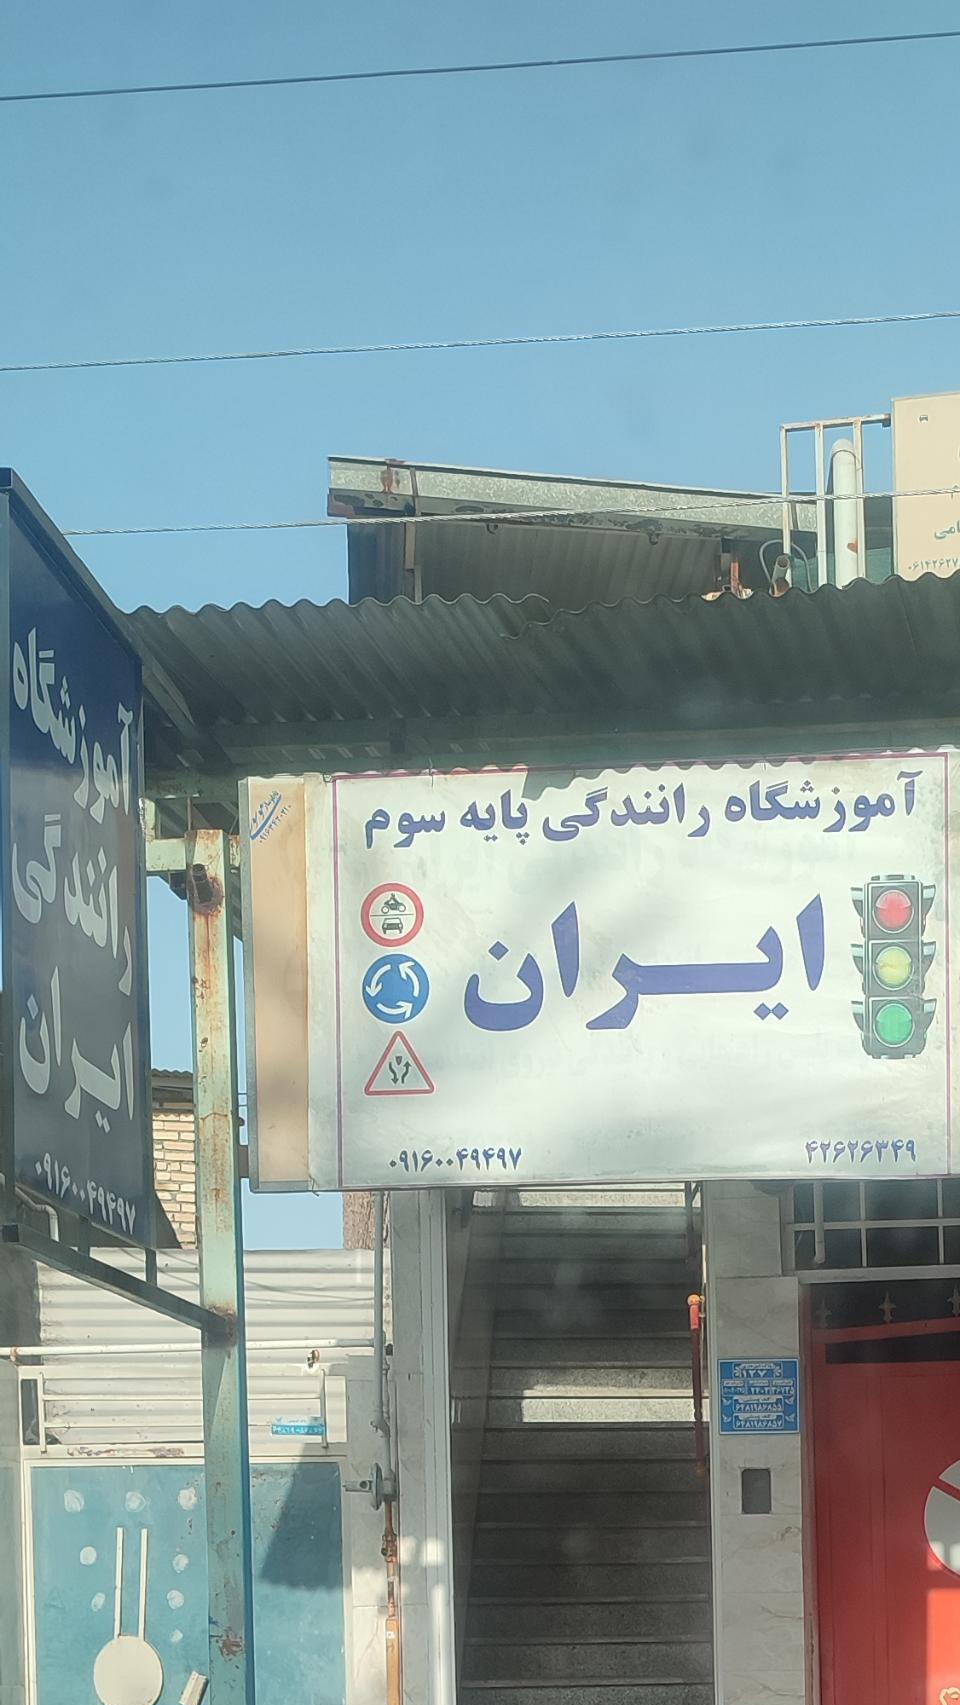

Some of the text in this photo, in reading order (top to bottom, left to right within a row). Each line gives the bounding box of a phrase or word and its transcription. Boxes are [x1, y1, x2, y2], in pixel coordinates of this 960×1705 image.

[13, 626, 134, 824] آموزشگاه
[364, 771, 922, 850] آموزشگاه رانندگی پایه سوم
[12, 813, 133, 997] رانندگی
[463, 894, 827, 1033] ایران
[19, 966, 134, 1133] ایران
[35, 1152, 136, 1235] ۰۹۱۶۰۰۴۹۴۹۷
[389, 1147, 522, 1171] ۰۹۱۶۰۰۴۹۴۹۷
[805, 1138, 917, 1165] ۴۲۶۲۶۳۴۹
